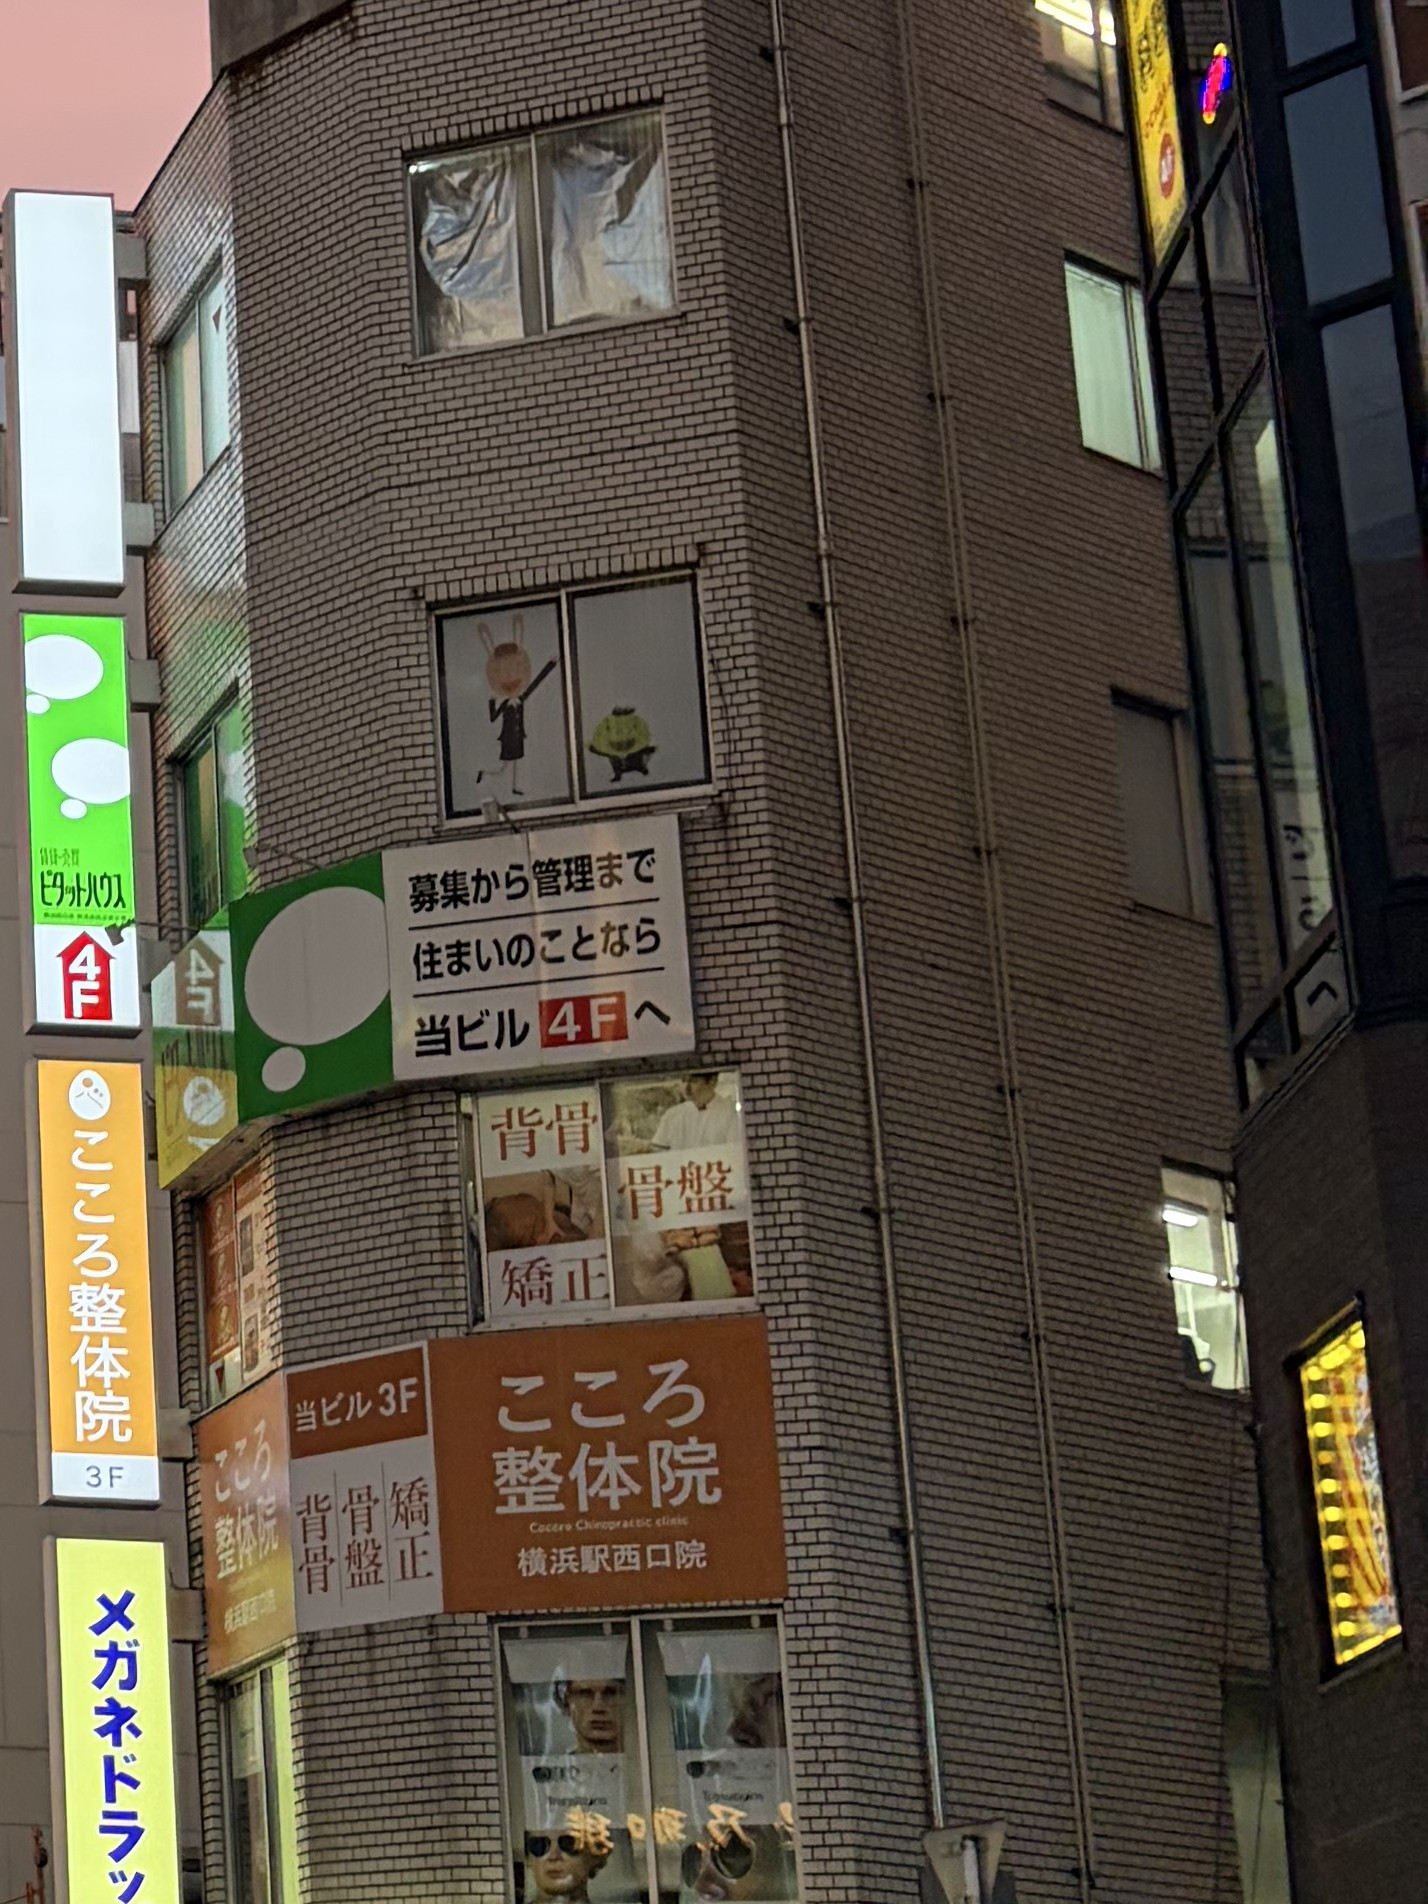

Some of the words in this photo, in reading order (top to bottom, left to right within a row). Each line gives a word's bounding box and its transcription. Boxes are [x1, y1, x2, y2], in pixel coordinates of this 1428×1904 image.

[40, 870, 126, 909] ピタットハウス
[409, 846, 656, 913] 募集から管理まで
[67, 944, 99, 1019] 4F
[412, 918, 662, 981] 住まいのことなら
[490, 1100, 597, 1161] 背骨
[618, 1160, 736, 1220] 骨盤
[68, 1128, 131, 1444] こころ整体院
[502, 1252, 610, 1309] 矯正
[498, 1358, 706, 1433] こころ
[87, 1464, 123, 1489] 3F
[215, 1419, 271, 1502] こころ
[492, 1436, 722, 1516] 整体院
[215, 1493, 278, 1578] 整体院
[296, 1493, 336, 1596] 背骨
[343, 1485, 386, 1591] 骨盤
[389, 1478, 435, 1584] 矯正
[517, 1539, 708, 1578] 横浜駅西口院
